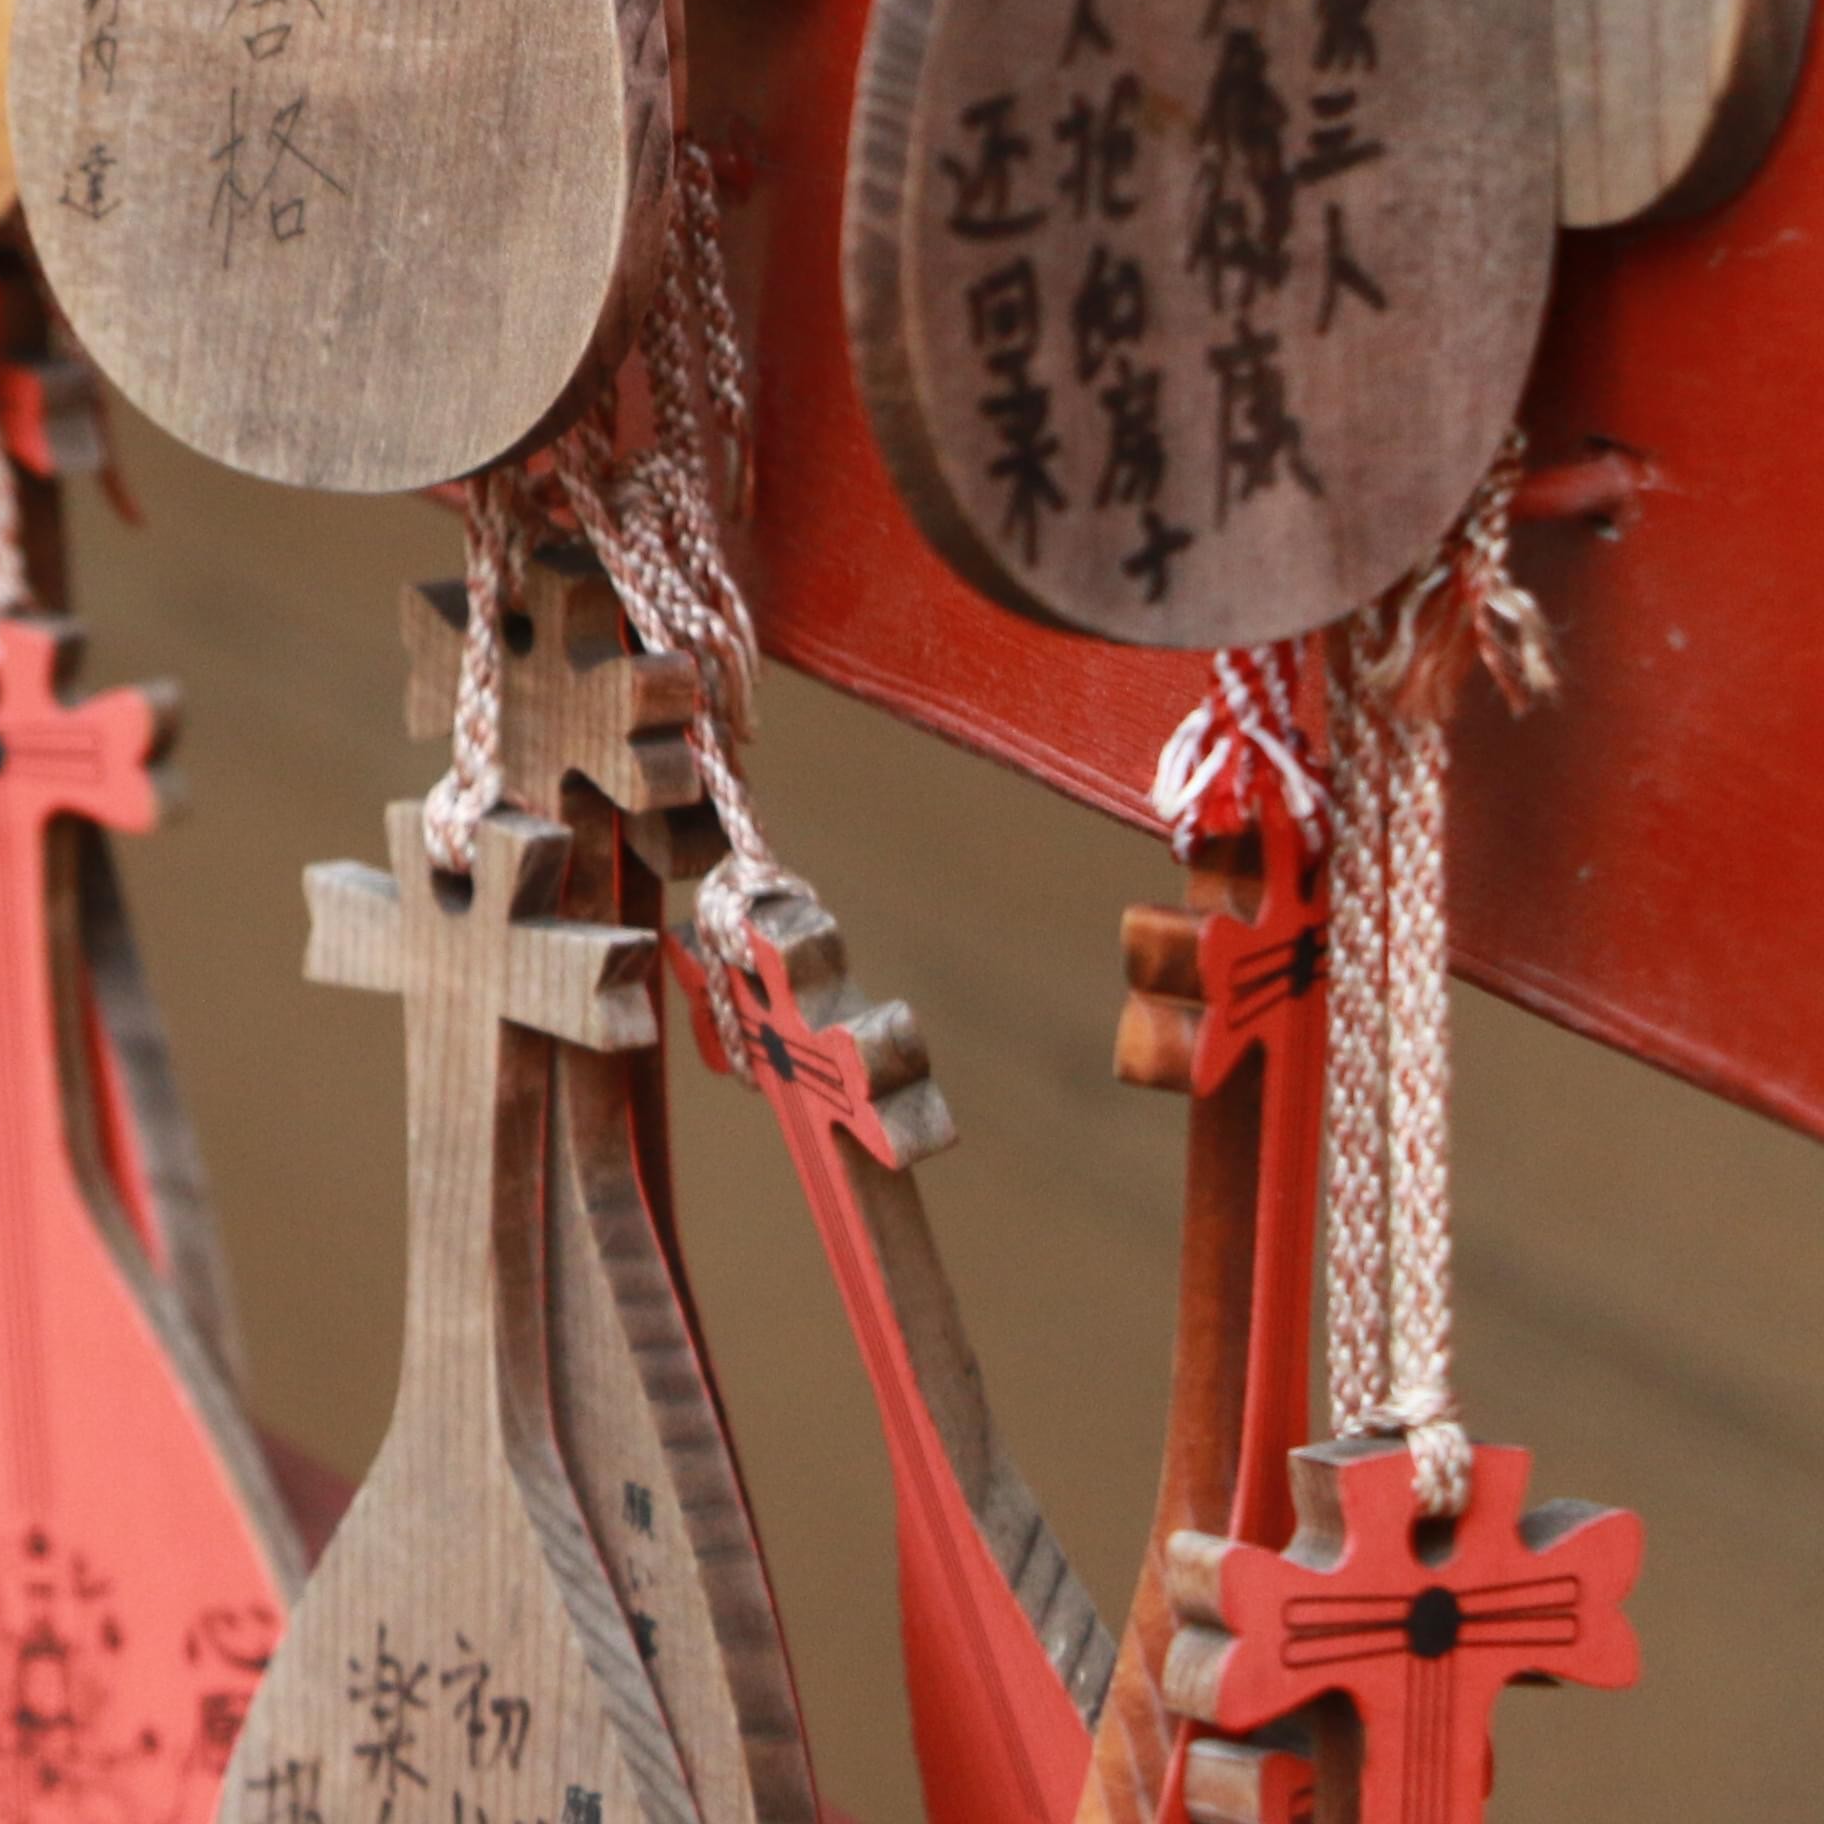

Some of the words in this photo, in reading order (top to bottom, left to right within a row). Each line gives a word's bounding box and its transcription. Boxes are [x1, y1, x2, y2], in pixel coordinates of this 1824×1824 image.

[58, 143, 125, 222] 達
[622, 1480, 658, 1663] 願い事
